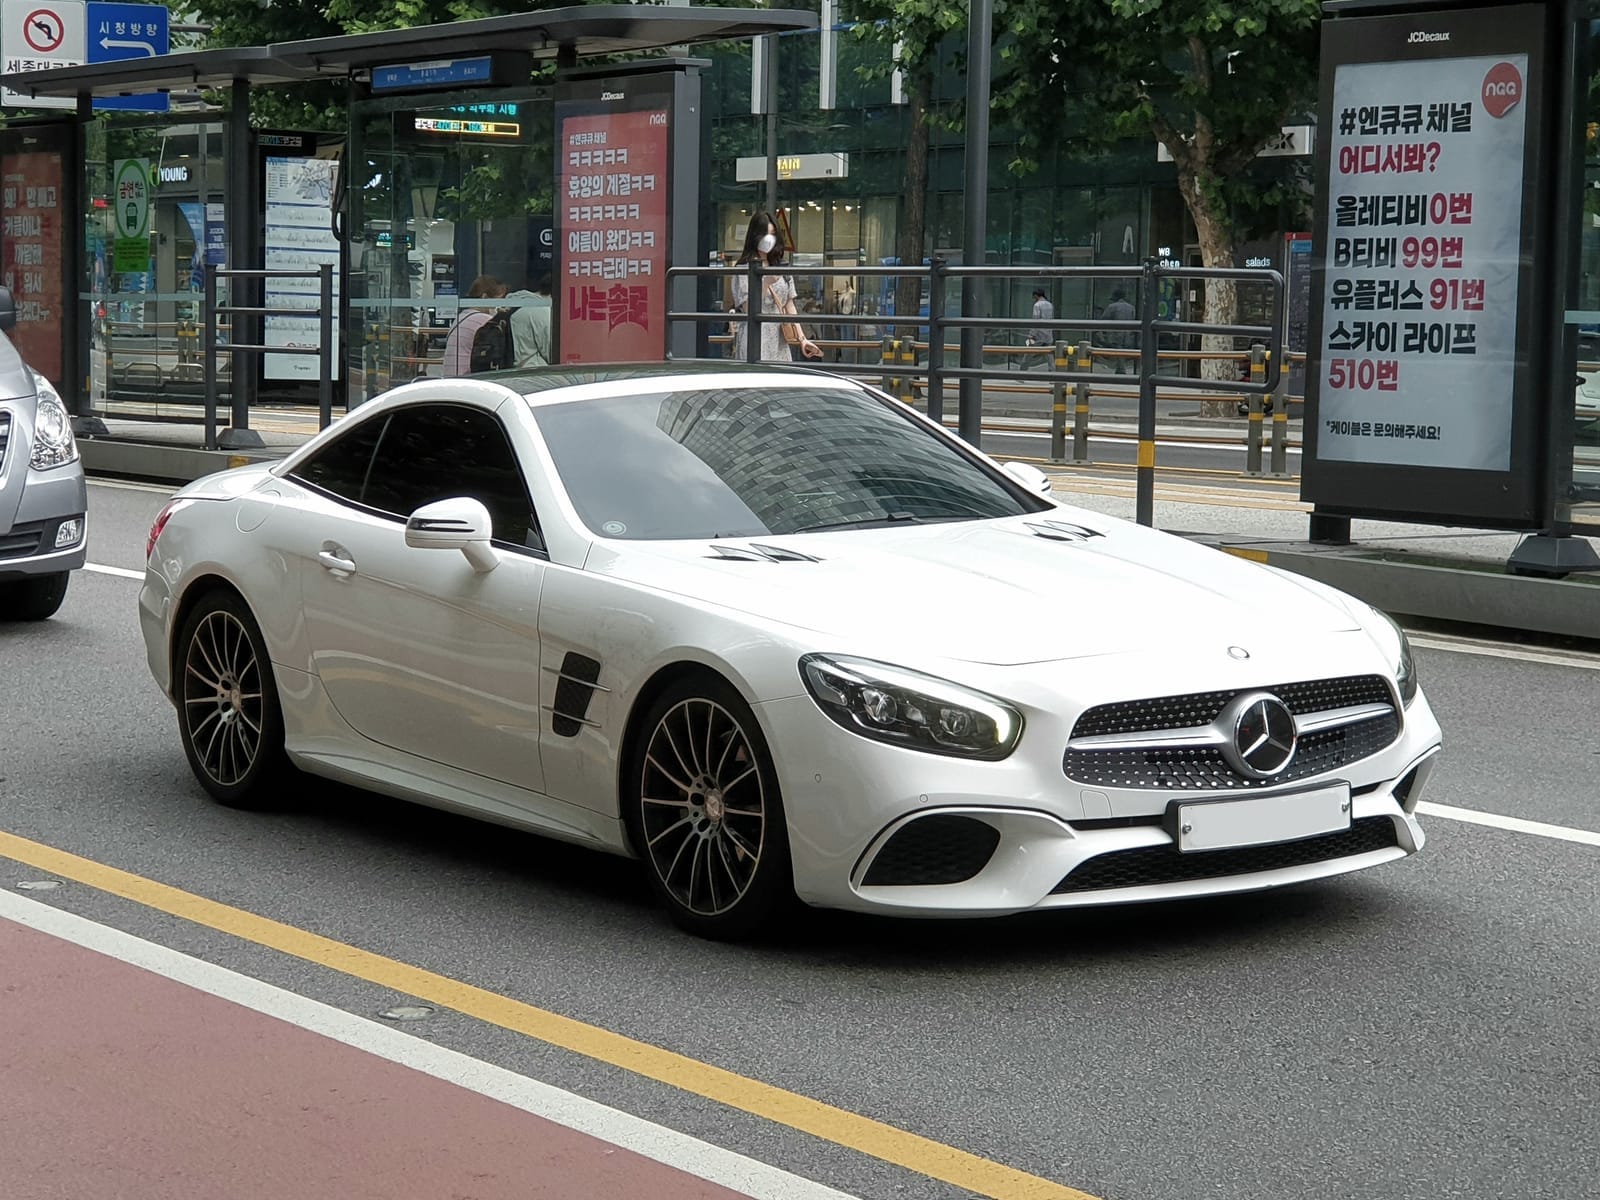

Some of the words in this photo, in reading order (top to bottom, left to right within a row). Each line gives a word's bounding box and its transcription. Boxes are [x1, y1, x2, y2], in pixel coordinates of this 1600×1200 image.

[1408, 31, 1449, 43] JCDecaux
[1340, 103, 1423, 135] #엔큐큐
[1426, 102, 1472, 134] 채널
[160, 166, 188, 182] YOUNG
[1338, 142, 1441, 175] 어디서봐?
[568, 175, 604, 198] 휴양의
[1335, 195, 1428, 227] 올레티비
[1429, 192, 1473, 225] 0번
[568, 230, 603, 253] 여름이
[1334, 238, 1397, 269] B티비
[1401, 237, 1464, 269] 99번
[1245, 256, 1271, 268] salads
[1330, 279, 1424, 311] 유플러스
[1429, 278, 1485, 311] 91번
[1328, 321, 1398, 353] 스카이
[1403, 323, 1477, 354] 라이프
[1328, 359, 1399, 391] 510번
[1373, 422, 1441, 440] 문의해주세요!
